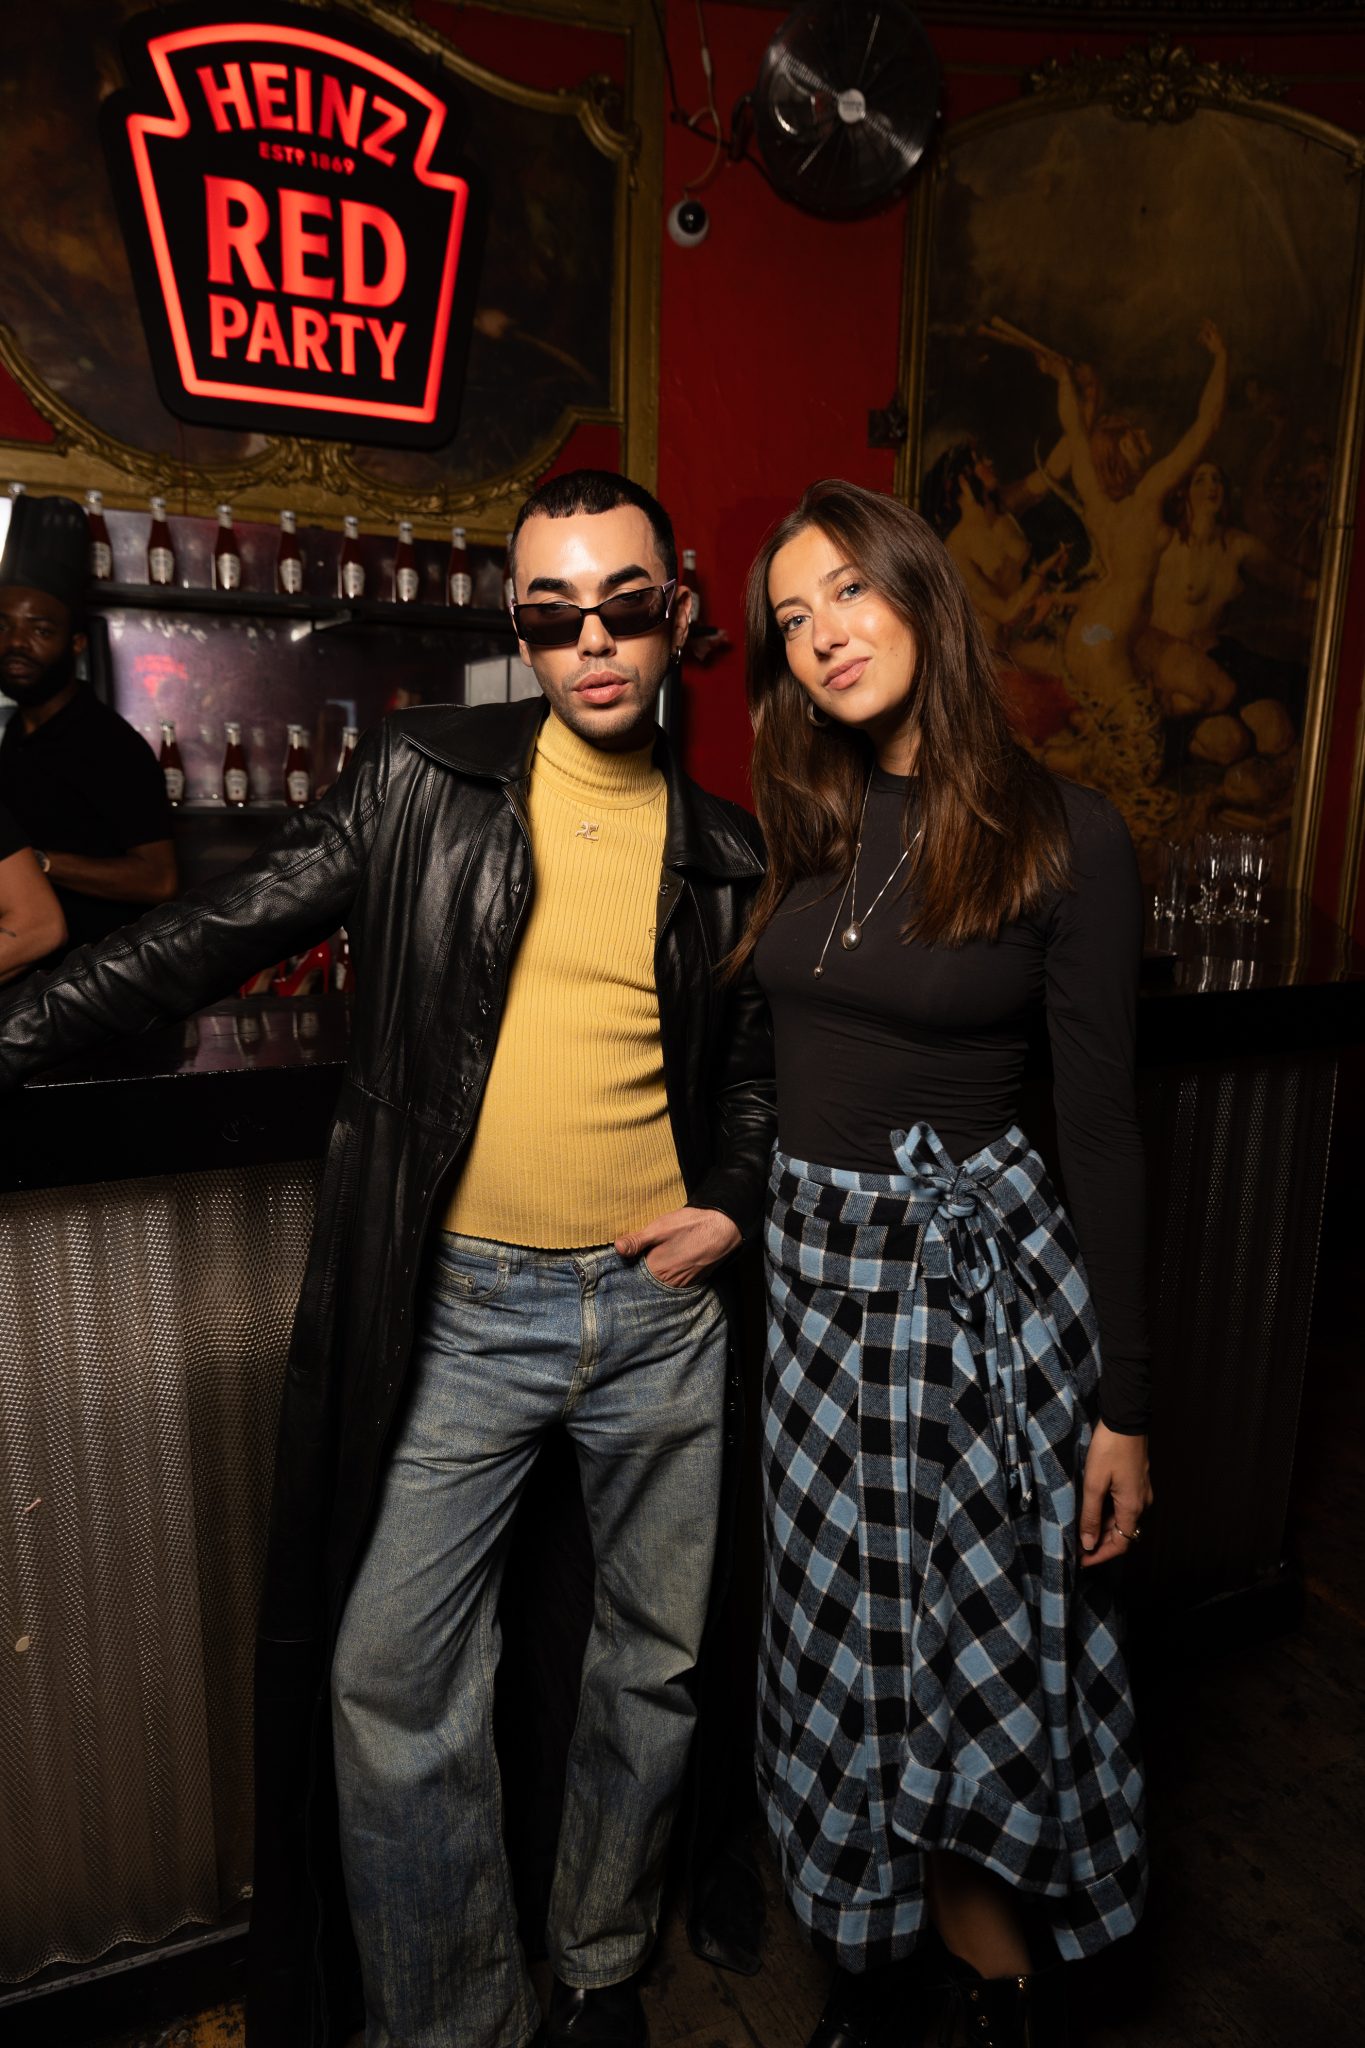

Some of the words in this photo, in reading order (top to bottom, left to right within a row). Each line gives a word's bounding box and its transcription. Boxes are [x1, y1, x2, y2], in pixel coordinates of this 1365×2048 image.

[196, 62, 408, 167] HEINZ
[310, 151, 356, 175] 1869
[203, 174, 407, 308] RED
[208, 293, 407, 381] PARTY
